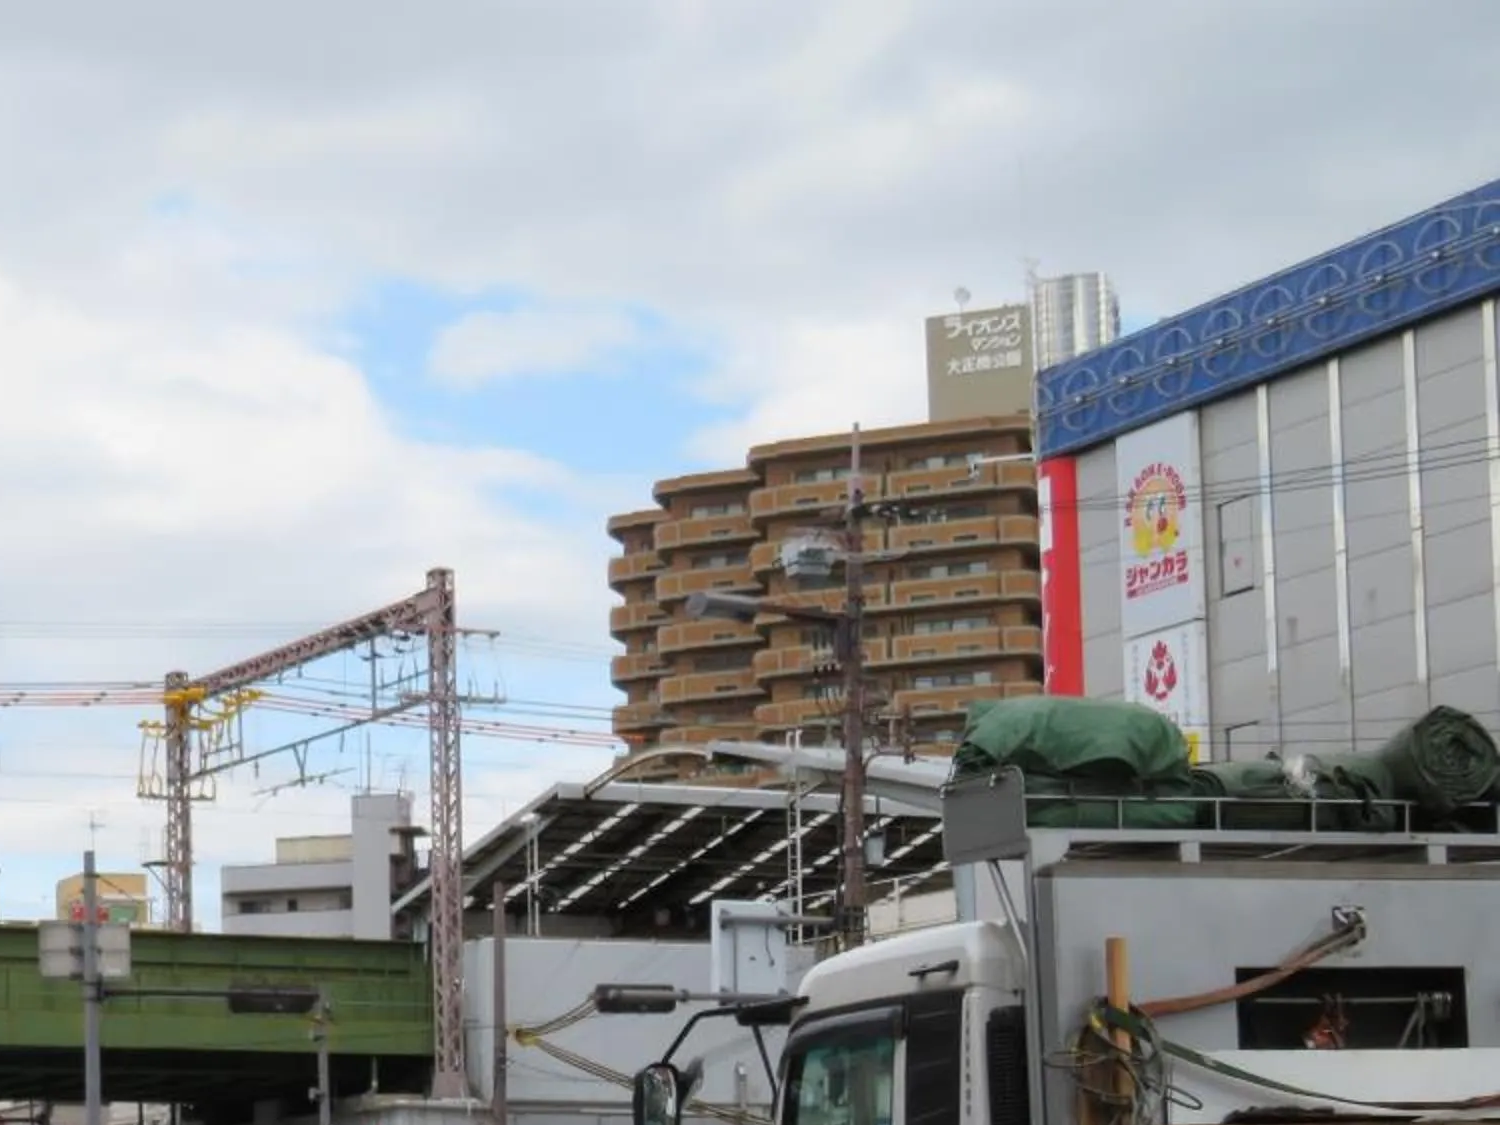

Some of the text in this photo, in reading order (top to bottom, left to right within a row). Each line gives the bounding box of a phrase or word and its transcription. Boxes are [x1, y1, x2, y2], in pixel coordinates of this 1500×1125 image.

[1126, 551, 1189, 588] ジャンカラ
